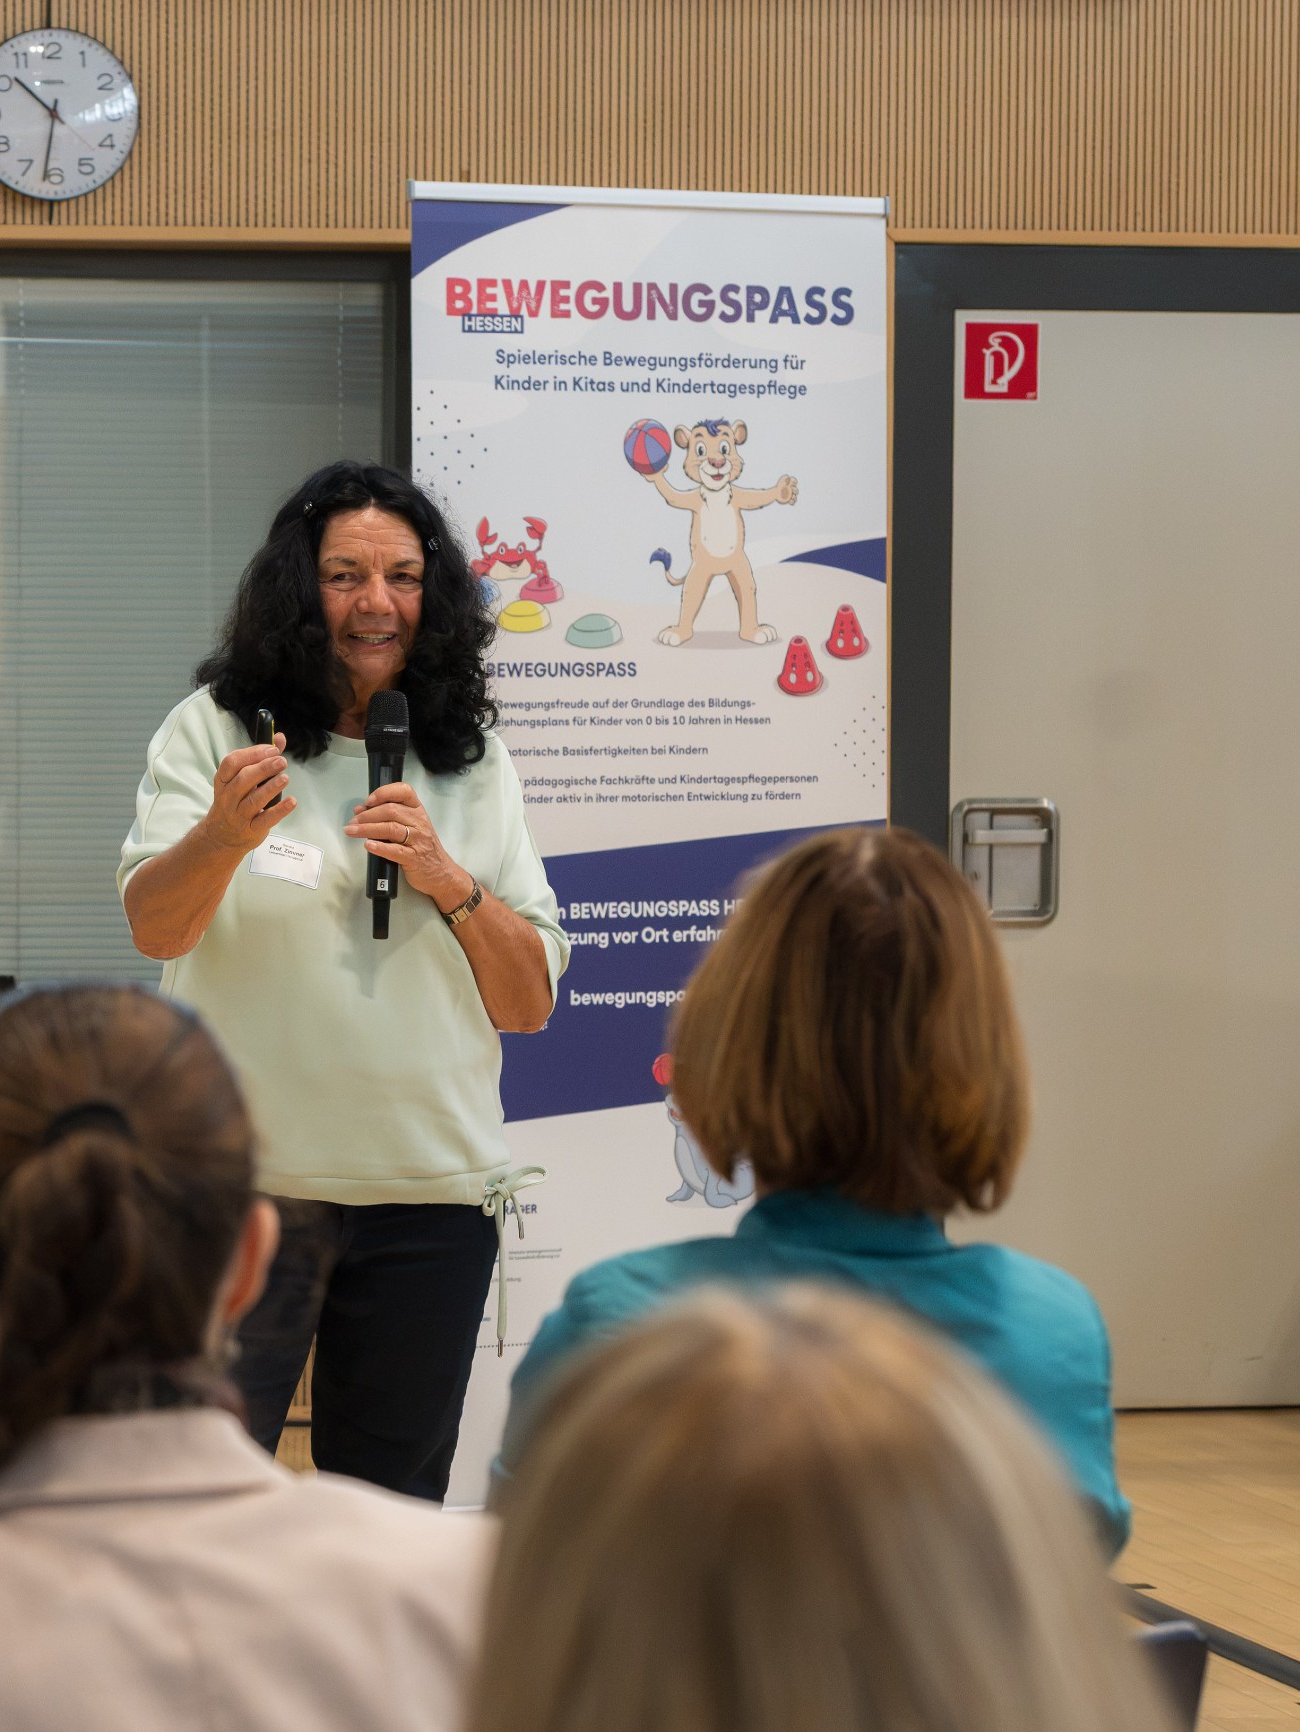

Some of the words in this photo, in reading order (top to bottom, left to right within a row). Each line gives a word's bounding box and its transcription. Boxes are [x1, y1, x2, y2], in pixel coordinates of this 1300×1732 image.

[41, 42, 62, 59] 12
[79, 50, 86, 68] 1
[12, 52, 28, 69] 11
[97, 73, 114, 91] 2
[104, 103, 122, 122] 3
[98, 133, 115, 150] 4
[17, 159, 34, 177] 7
[78, 157, 95, 175] 5
[46, 167, 64, 185] 6
[446, 277, 854, 326] BEWEGUNGSPASS
[463, 316, 522, 332] HESSEN
[495, 349, 597, 368] Spielerische
[603, 351, 778, 373] Bewegungsförderung
[783, 354, 806, 370] für
[494, 375, 549, 391] Kinder
[554, 376, 567, 391] in
[573, 376, 615, 392] Kitas
[620, 378, 651, 393] und
[656, 378, 807, 399] Kindertagespflege
[487, 662, 637, 678] BEWEGUNGSPASS
[592, 699, 611, 709] auf
[612, 699, 628, 709] der
[631, 698, 685, 710] Grundlage
[687, 698, 705, 708] des
[708, 698, 756, 710] Bildungs-
[496, 716, 570, 728] ziehungsplans
[572, 716, 588, 726] für
[589, 716, 622, 726] Kinder
[626, 717, 643, 726] von
[645, 716, 652, 726] 0
[655, 716, 669, 726] bis
[672, 716, 685, 725] 10
[688, 715, 721, 725] Jahren
[723, 715, 732, 725] in
[735, 715, 771, 725] Hessen
[562, 746, 648, 758] Basisfertigkeiten
[651, 745, 666, 756] bei
[669, 745, 708, 755] Kindern
[524, 776, 597, 788] pädagogische
[600, 775, 656, 785] Fachkräfte
[658, 775, 677, 785] und
[680, 774, 819, 786] Kindertagespflegepersonen
[556, 793, 581, 803] aktiv
[584, 793, 593, 803] in
[596, 793, 619, 803] ihrer
[621, 792, 683, 802] motorischen
[687, 791, 748, 803] Entwicklung
[751, 792, 762, 801] zu
[765, 791, 801, 800] fördern
[570, 899, 720, 919] BEWEGUNGSPASS
[612, 932, 638, 944] vor
[641, 927, 669, 943] Ort
[672, 925, 722, 942] erfahr
[570, 990, 685, 1008] bewegungspa
